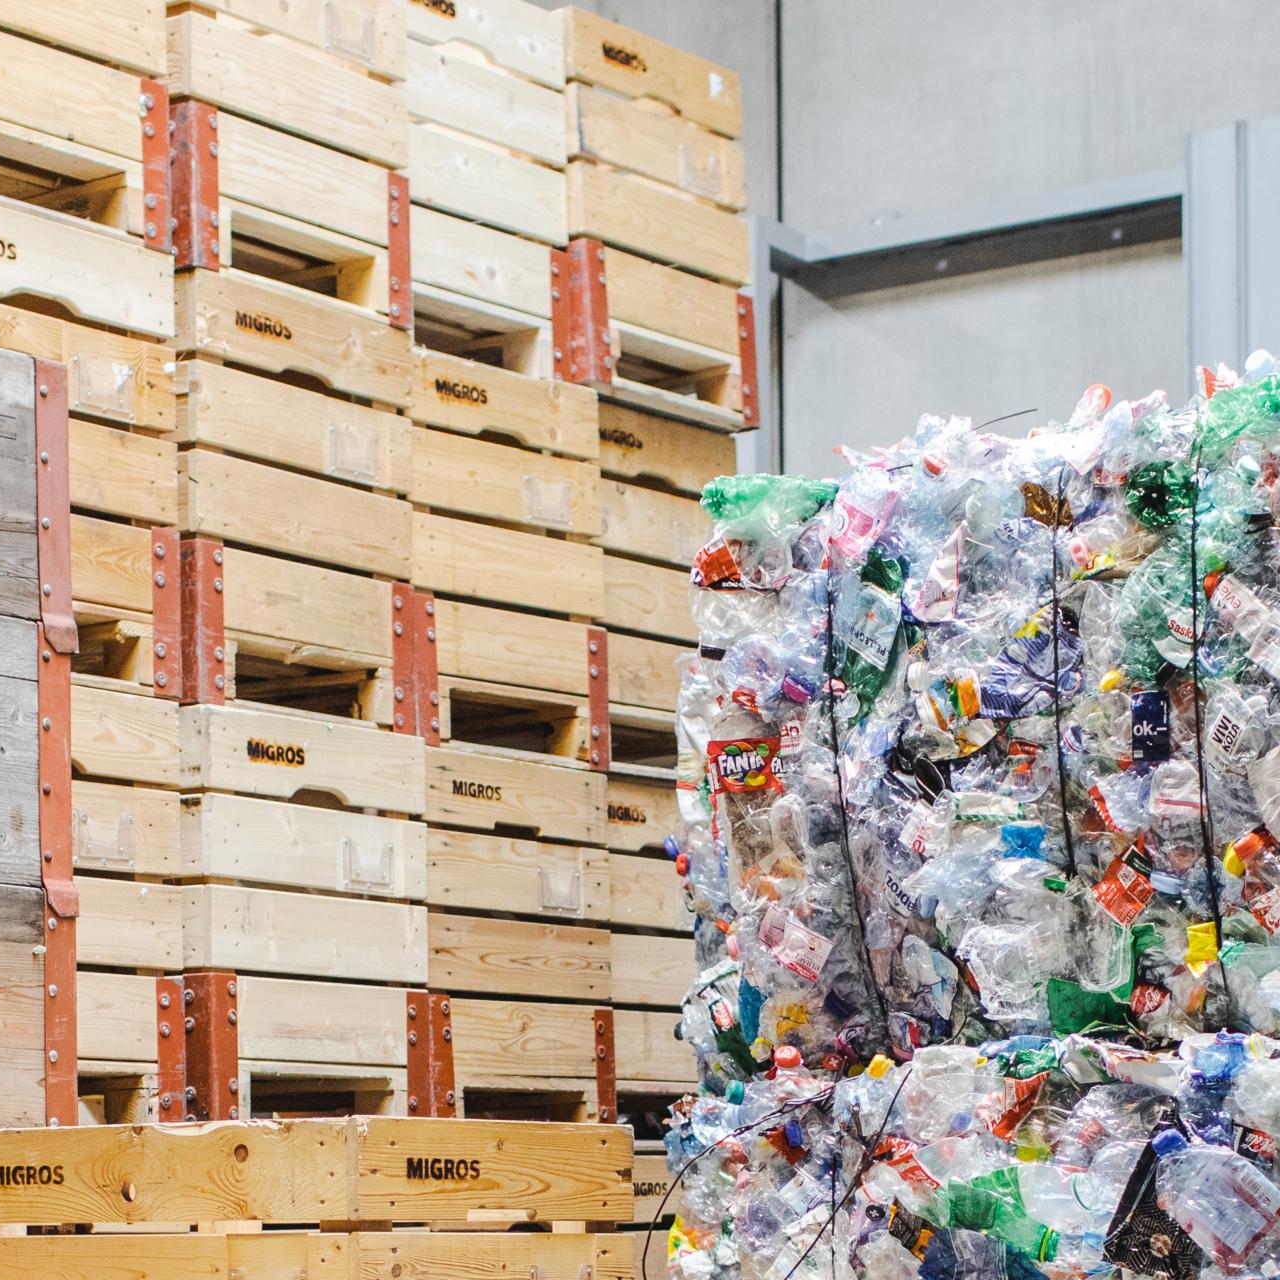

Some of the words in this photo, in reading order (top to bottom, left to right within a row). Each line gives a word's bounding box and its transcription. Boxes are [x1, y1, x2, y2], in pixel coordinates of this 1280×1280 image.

[235, 310, 293, 340] MIGROS
[435, 378, 488, 405] MIGROS
[1212, 715, 1232, 744] VIVI
[1221, 724, 1240, 752] KOLA
[246, 739, 305, 765] MIGROS
[718, 751, 765, 775] FANTA
[452, 779, 502, 800] MIGROS
[406, 1157, 481, 1181] MIGROS
